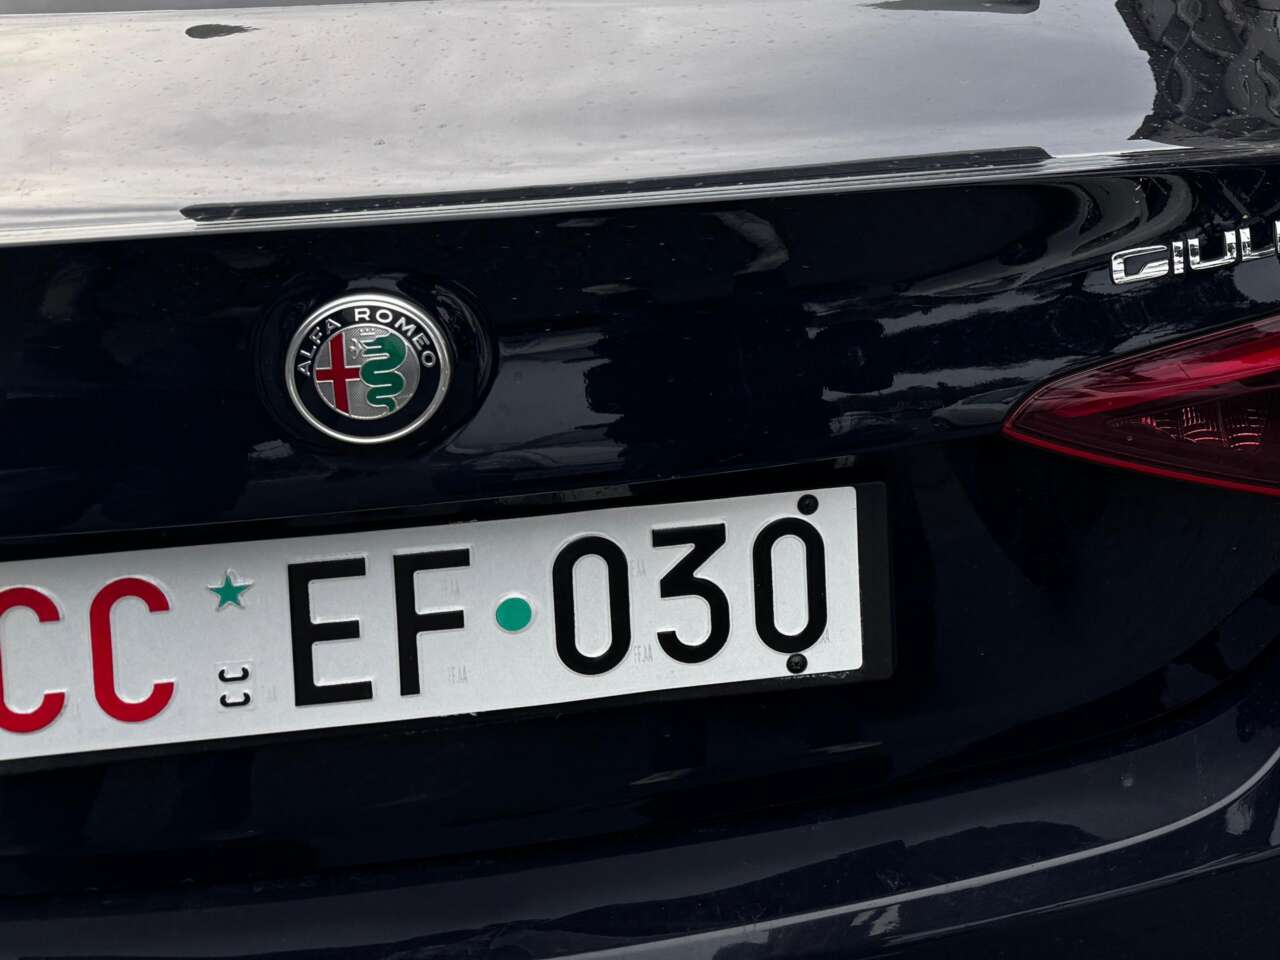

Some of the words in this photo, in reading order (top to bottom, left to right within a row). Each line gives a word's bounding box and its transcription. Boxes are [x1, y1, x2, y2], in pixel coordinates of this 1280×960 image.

[297, 318, 342, 376] ALFA
[354, 308, 436, 367] ROMEO
[0, 577, 175, 733] CC
[288, 548, 471, 706] EF
[552, 516, 828, 676] 030
